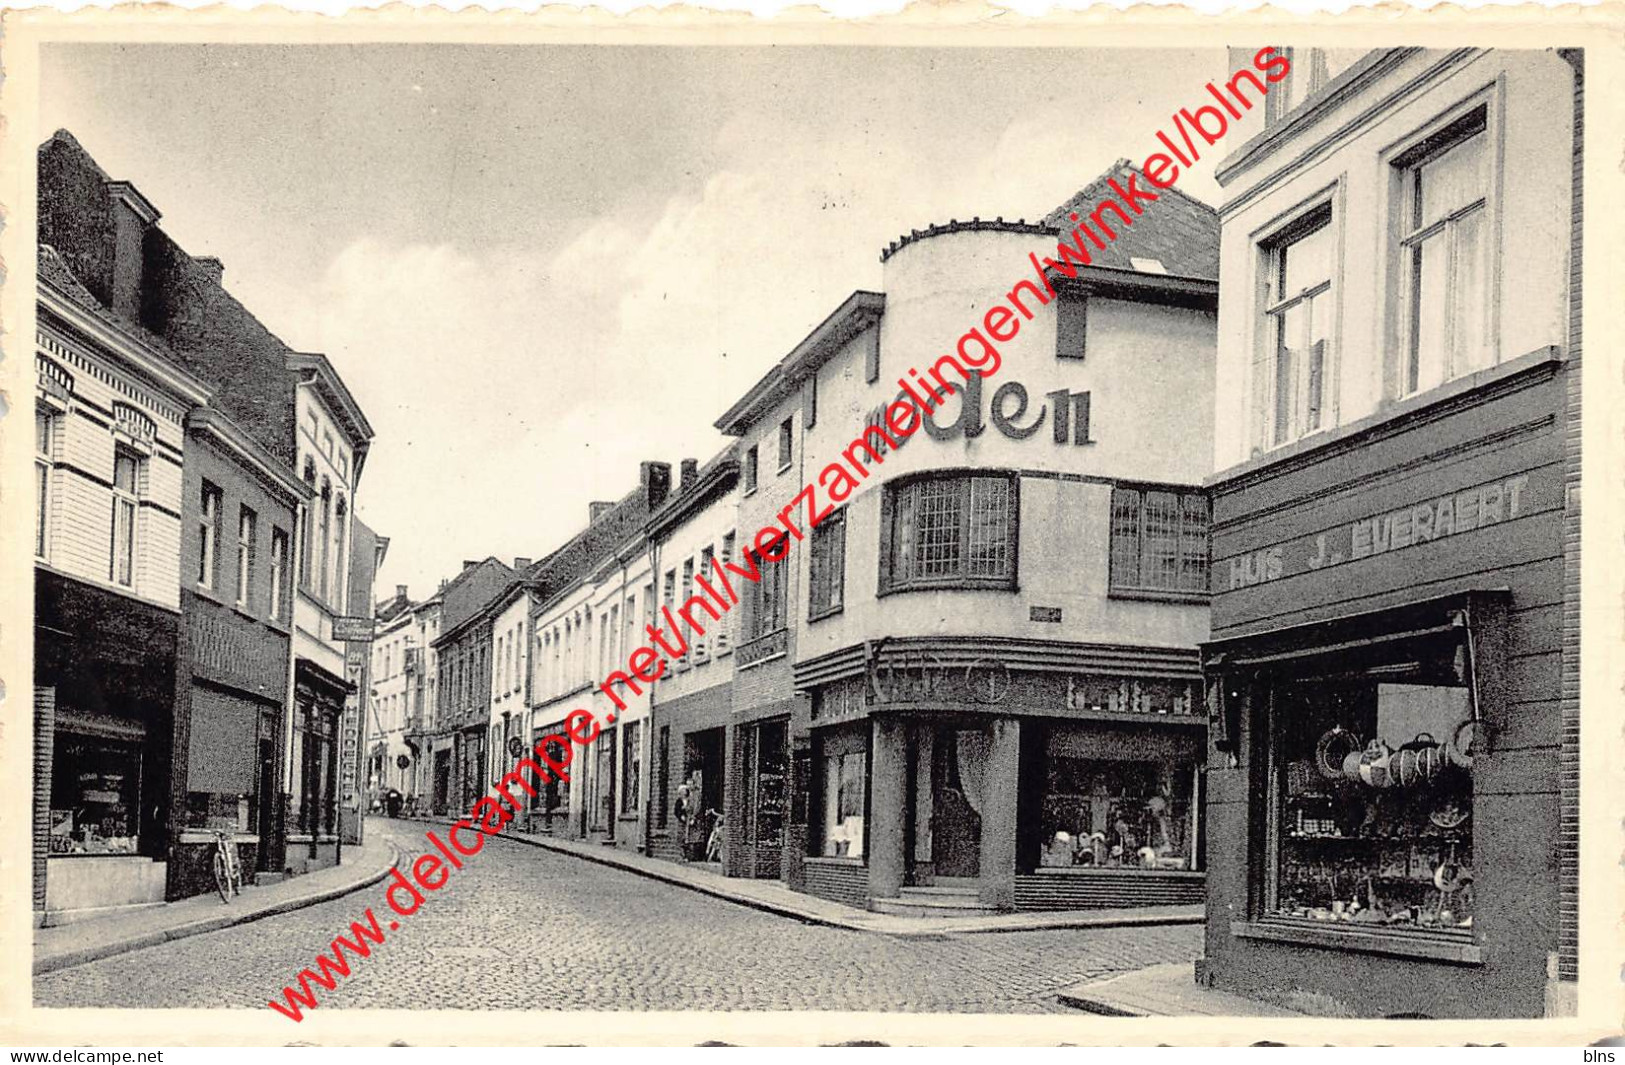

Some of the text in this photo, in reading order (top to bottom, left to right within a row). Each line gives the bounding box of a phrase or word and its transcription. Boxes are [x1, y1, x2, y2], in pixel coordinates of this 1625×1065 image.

[1229, 473, 1529, 590] HUIS J. EVERAERT
